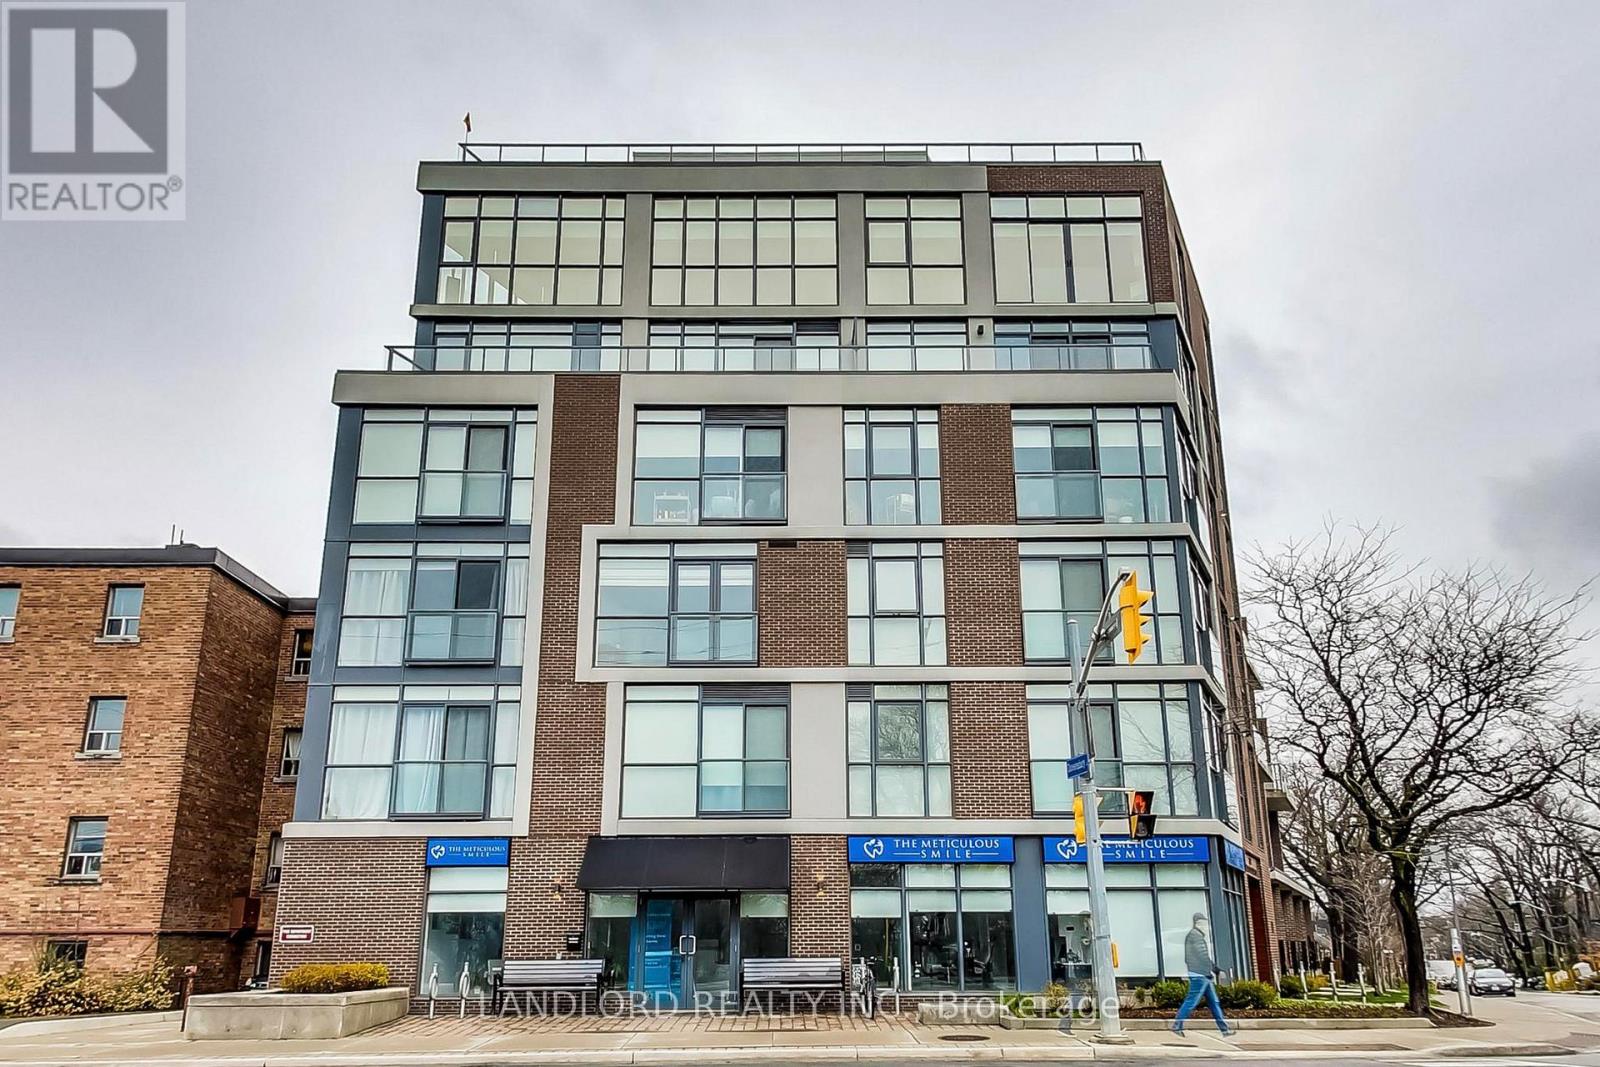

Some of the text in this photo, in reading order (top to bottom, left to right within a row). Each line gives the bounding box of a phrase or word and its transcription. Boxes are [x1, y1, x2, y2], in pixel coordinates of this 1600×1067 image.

[894, 839, 1000, 849] THE METICULOUS
[920, 849, 971, 859] SMILE
[1115, 849, 1166, 858] SMILE
